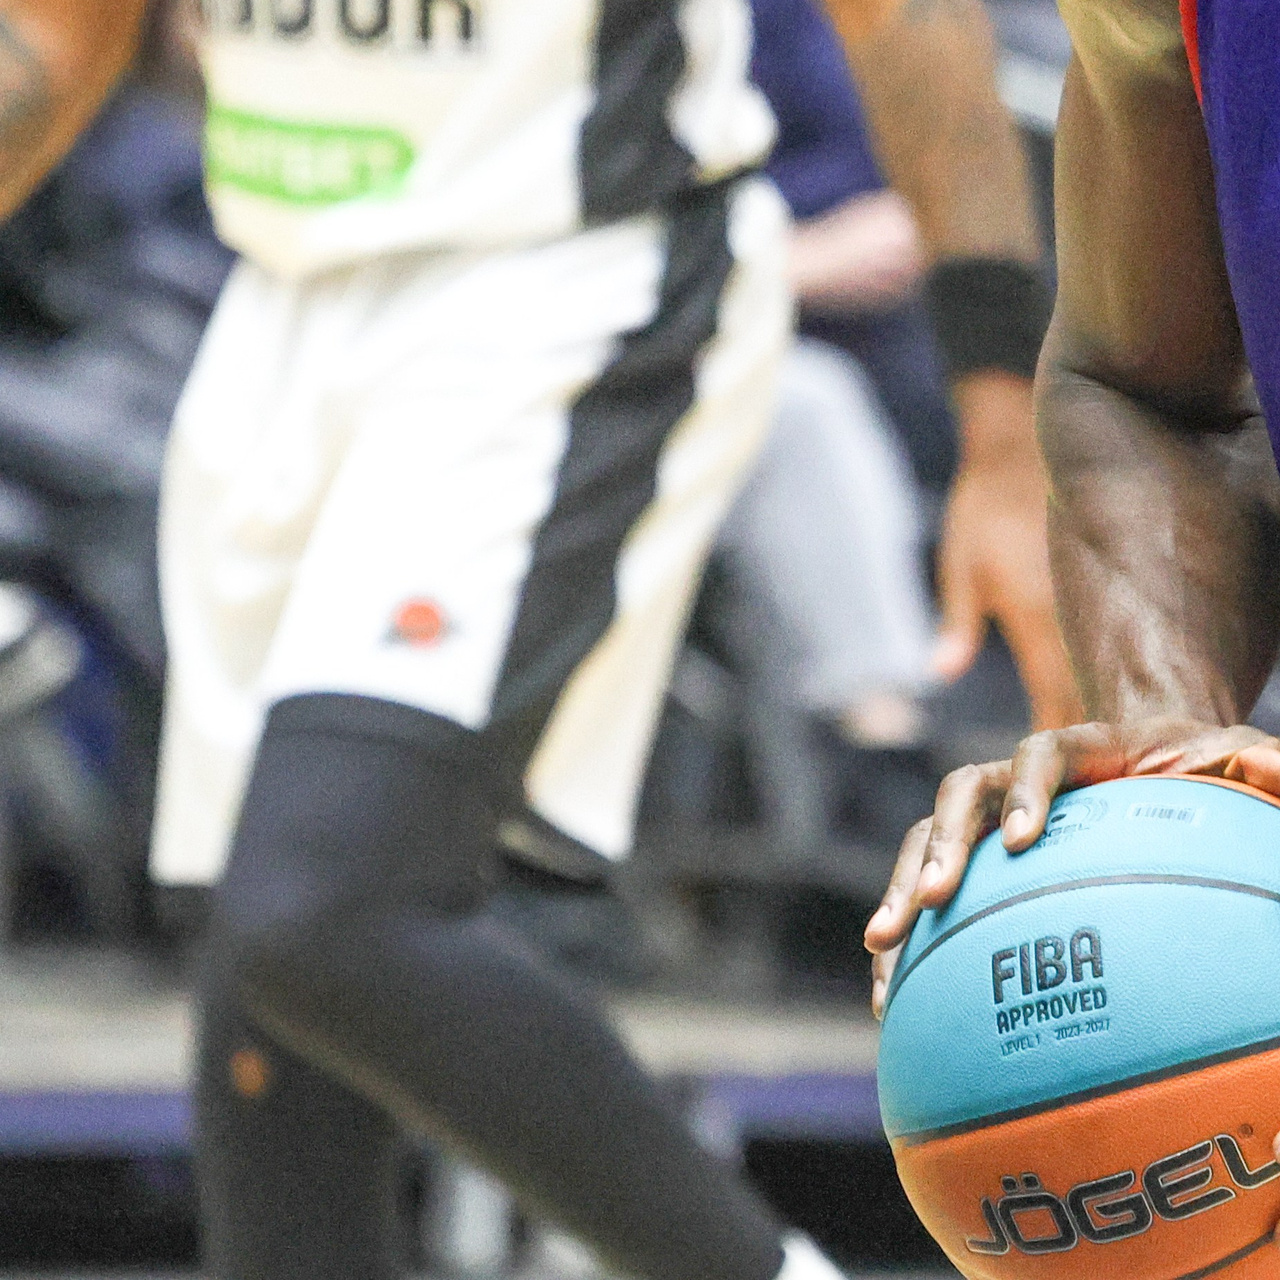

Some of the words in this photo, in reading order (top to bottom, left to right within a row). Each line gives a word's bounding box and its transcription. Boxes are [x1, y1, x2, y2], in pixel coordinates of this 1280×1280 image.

[991, 926, 1104, 1005] FIBA
[996, 986, 1108, 1035] APPROVED
[1000, 1035, 1034, 1057] LEVEL
